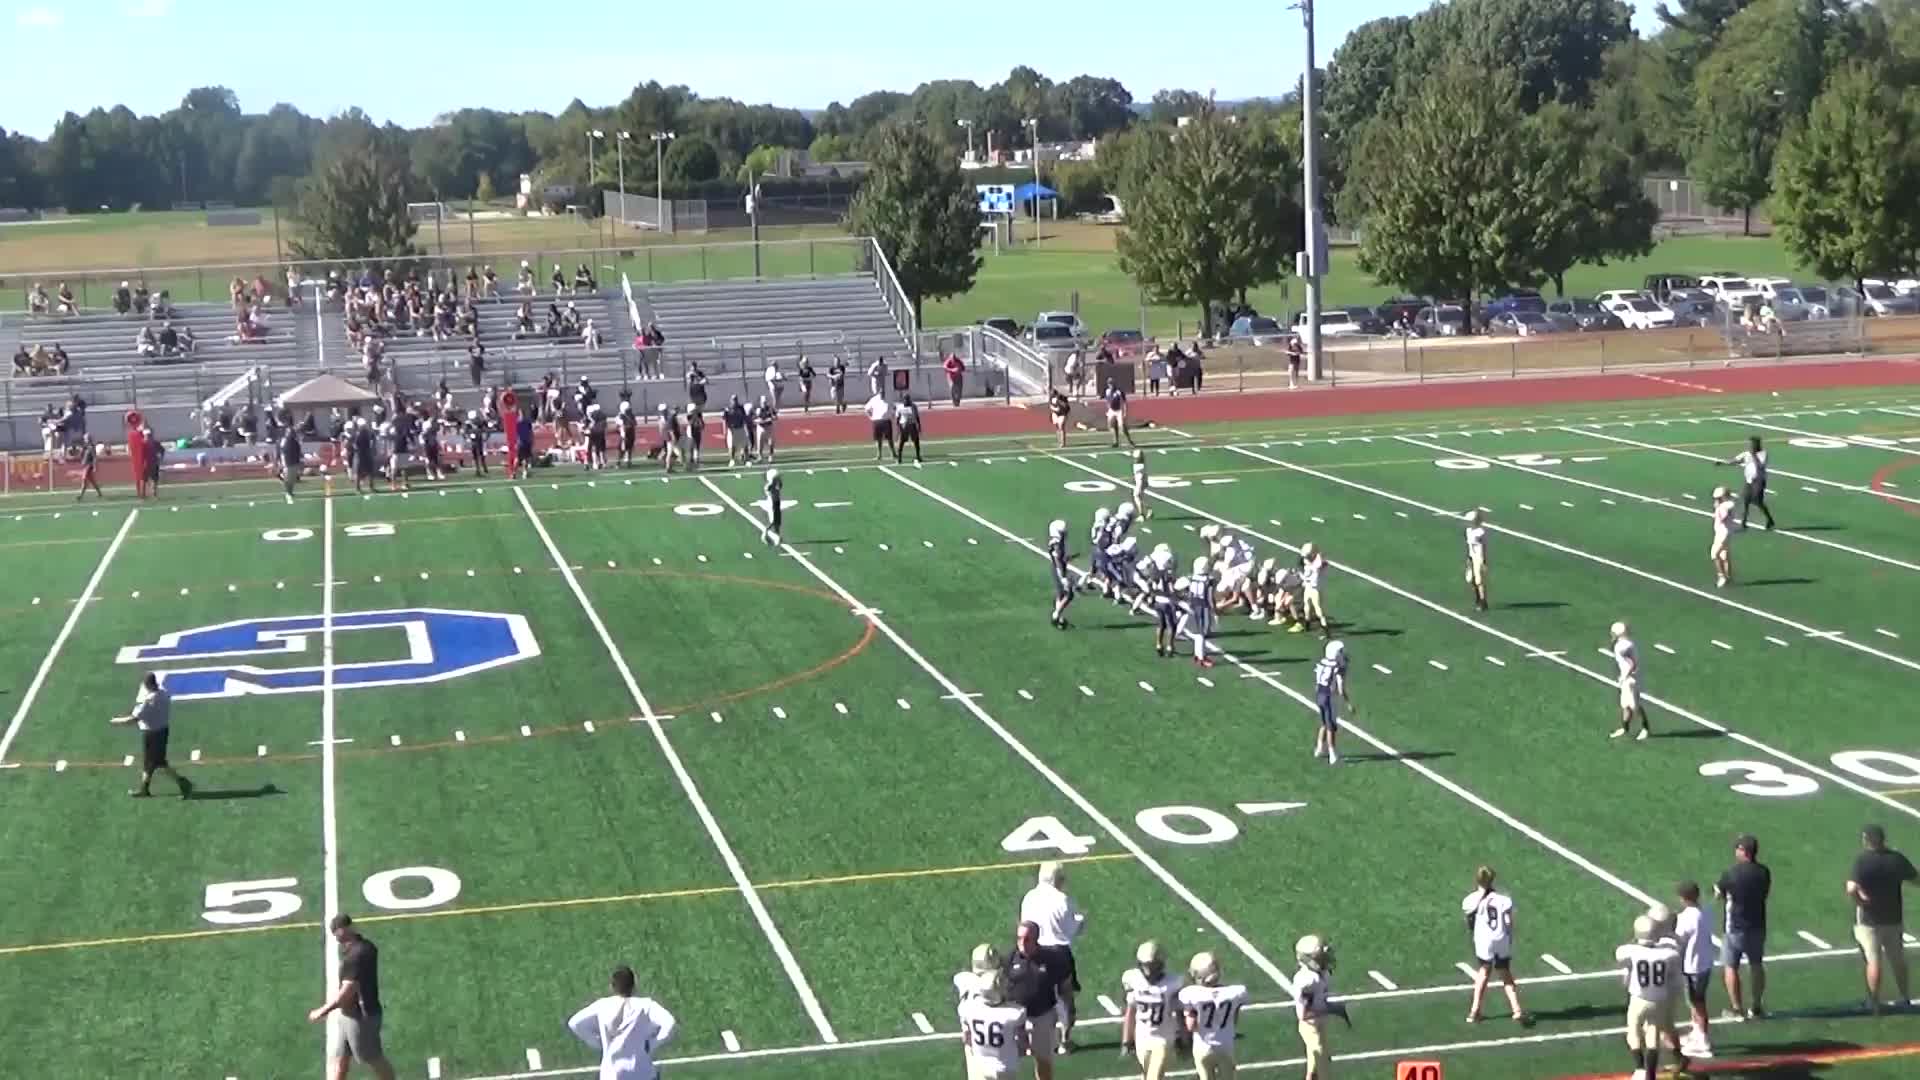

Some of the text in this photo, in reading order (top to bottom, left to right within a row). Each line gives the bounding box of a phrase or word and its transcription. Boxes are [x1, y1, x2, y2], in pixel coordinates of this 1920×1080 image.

[1636, 959, 1666, 988] 88
[1202, 1000, 1232, 1030] 77
[972, 1018, 1005, 1048] 56
